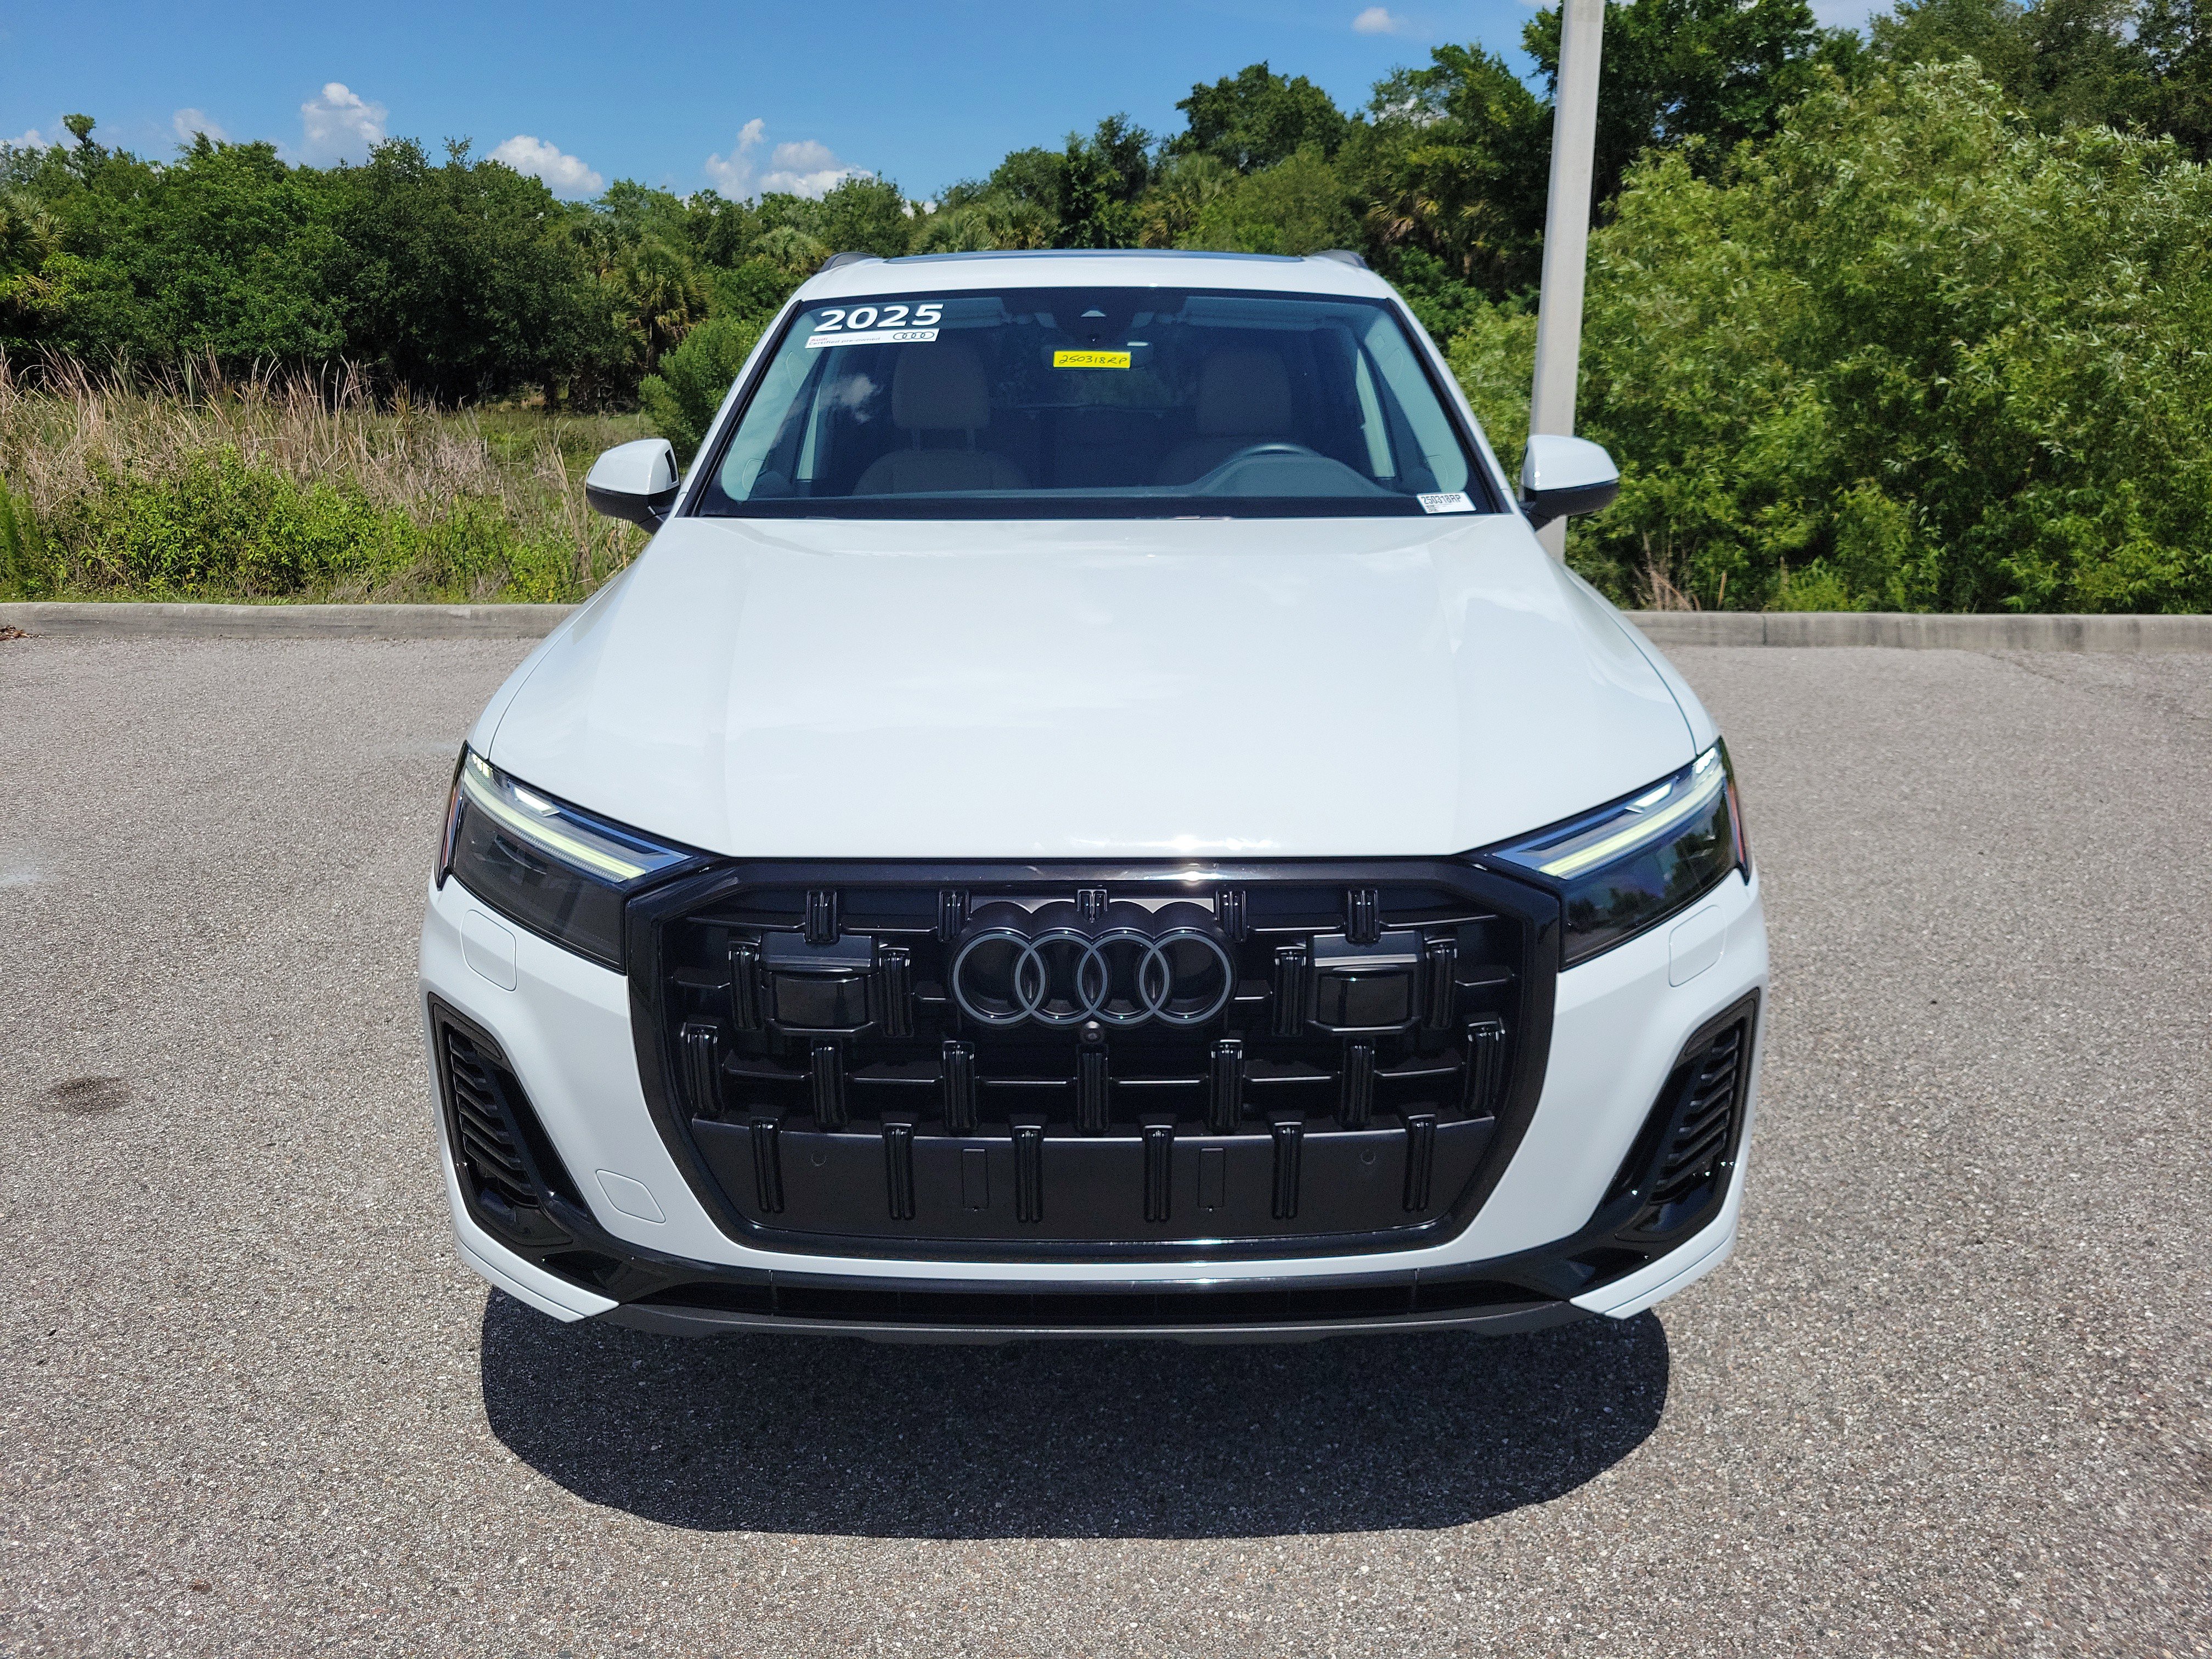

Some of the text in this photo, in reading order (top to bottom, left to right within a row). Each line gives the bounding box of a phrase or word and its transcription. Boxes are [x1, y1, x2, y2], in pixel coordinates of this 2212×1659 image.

[814, 304, 944, 331] 2025
[1059, 356, 1127, 364] 250318RP
[1421, 495, 1461, 504] 250318RP
